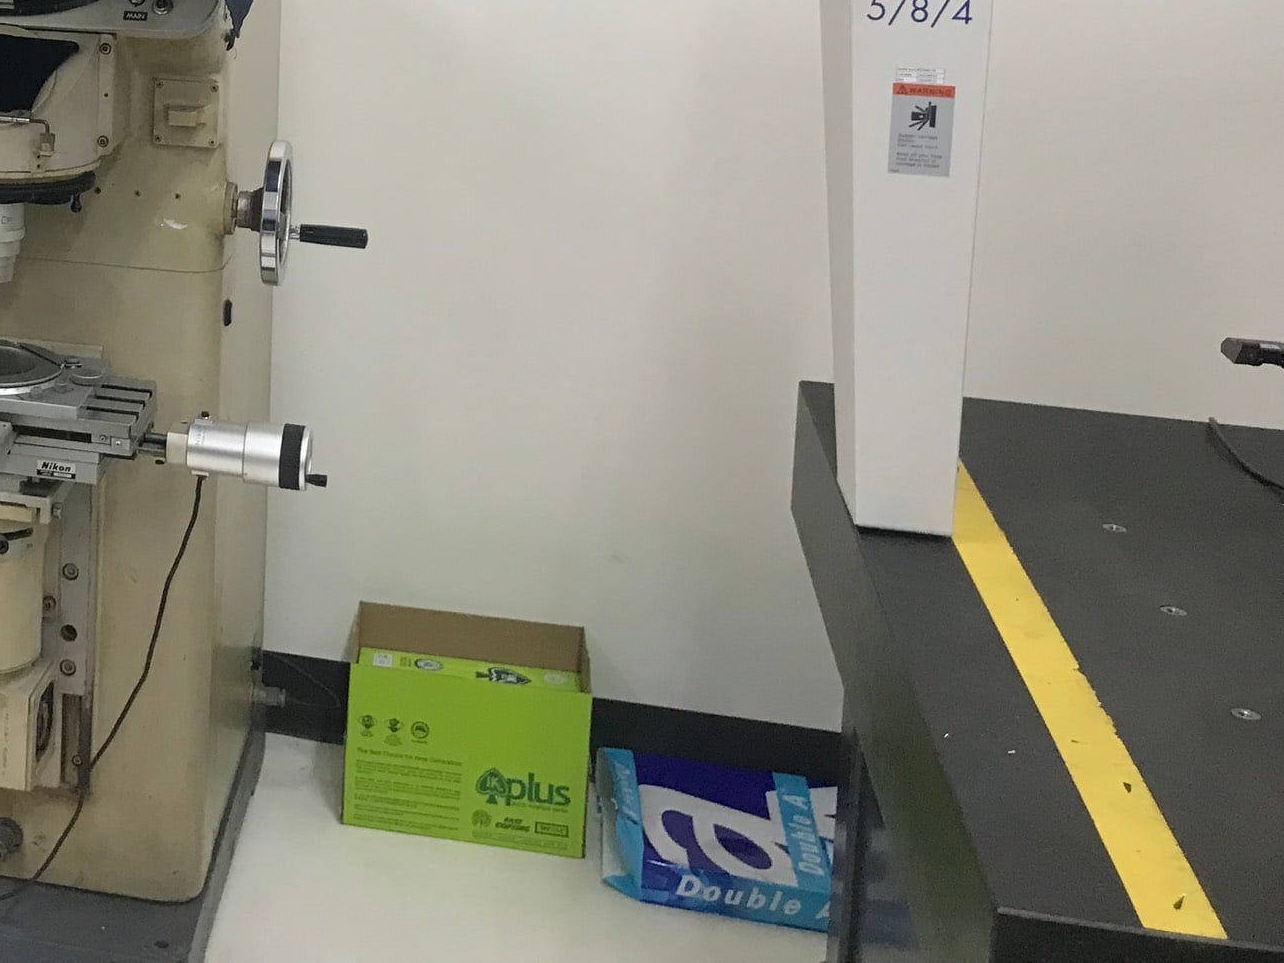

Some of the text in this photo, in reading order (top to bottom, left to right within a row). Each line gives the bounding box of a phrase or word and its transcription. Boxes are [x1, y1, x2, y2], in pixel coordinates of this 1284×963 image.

[41, 461, 72, 472] Nikon
[782, 794, 825, 876] Double A
[675, 874, 802, 916] Double
